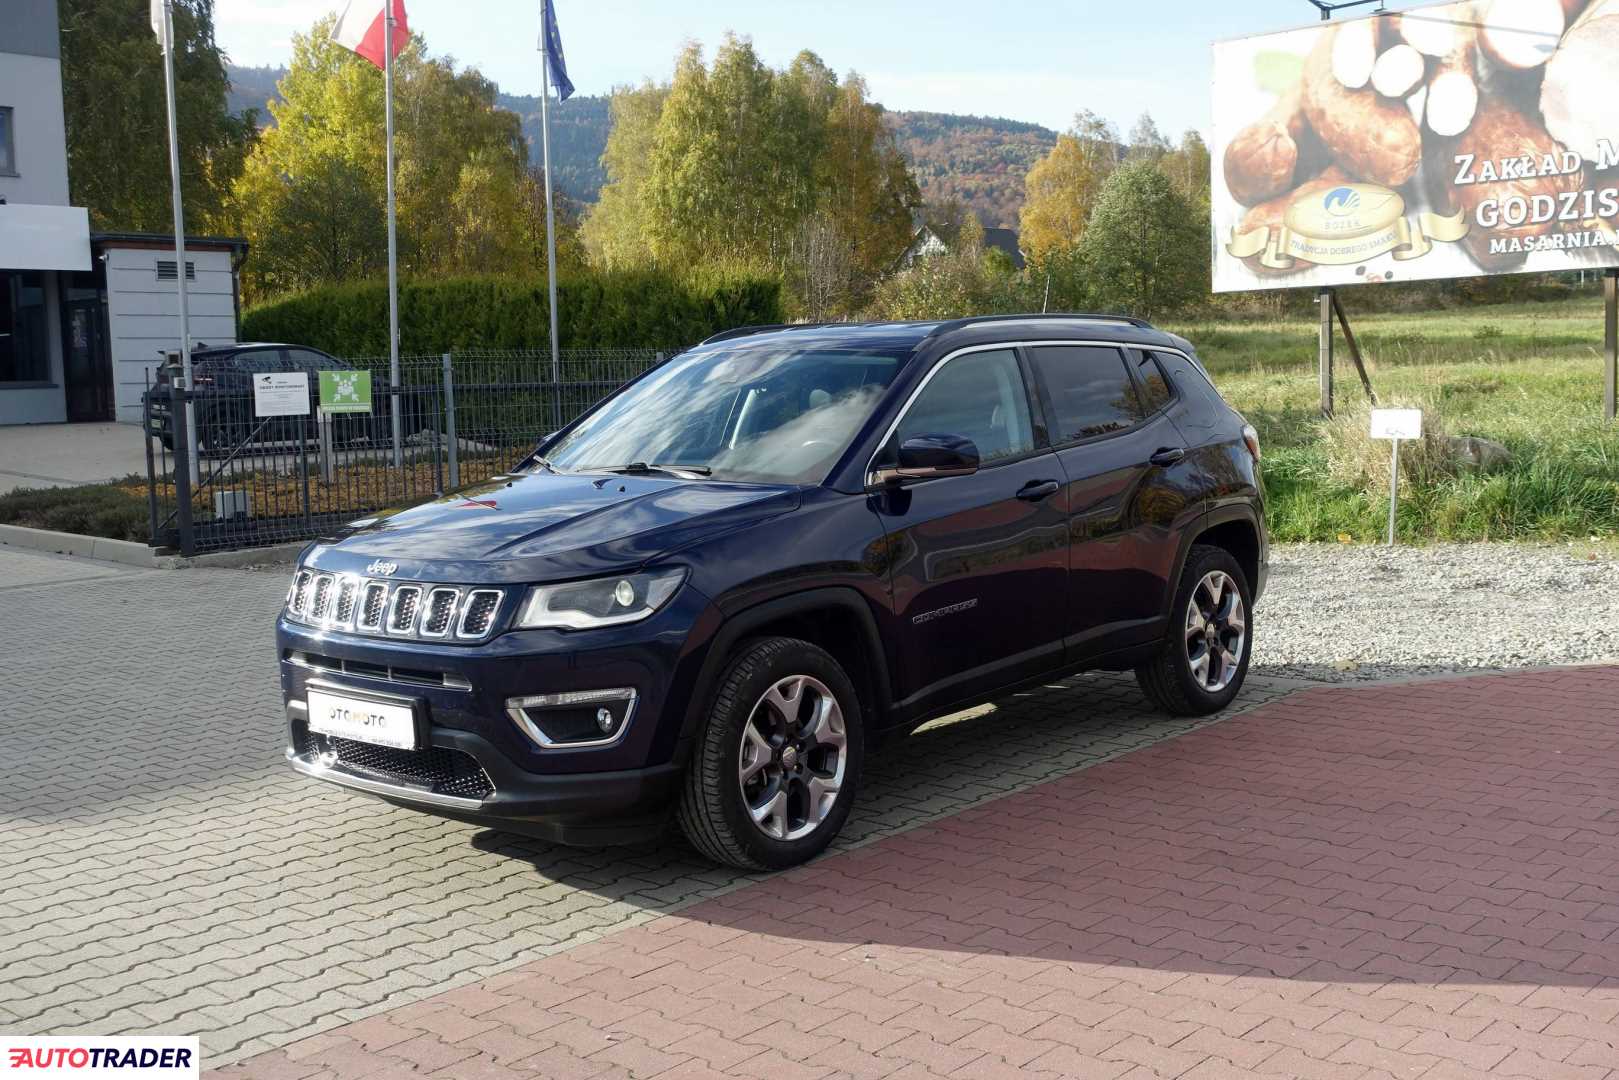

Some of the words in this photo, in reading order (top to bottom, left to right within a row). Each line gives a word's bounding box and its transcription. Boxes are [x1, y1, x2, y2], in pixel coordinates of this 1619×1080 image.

[1454, 151, 1582, 185] ZAKŁAD
[1476, 188, 1619, 227] GODZIS
[1489, 230, 1619, 254] MASARNIA.
[367, 559, 397, 576] Jeep
